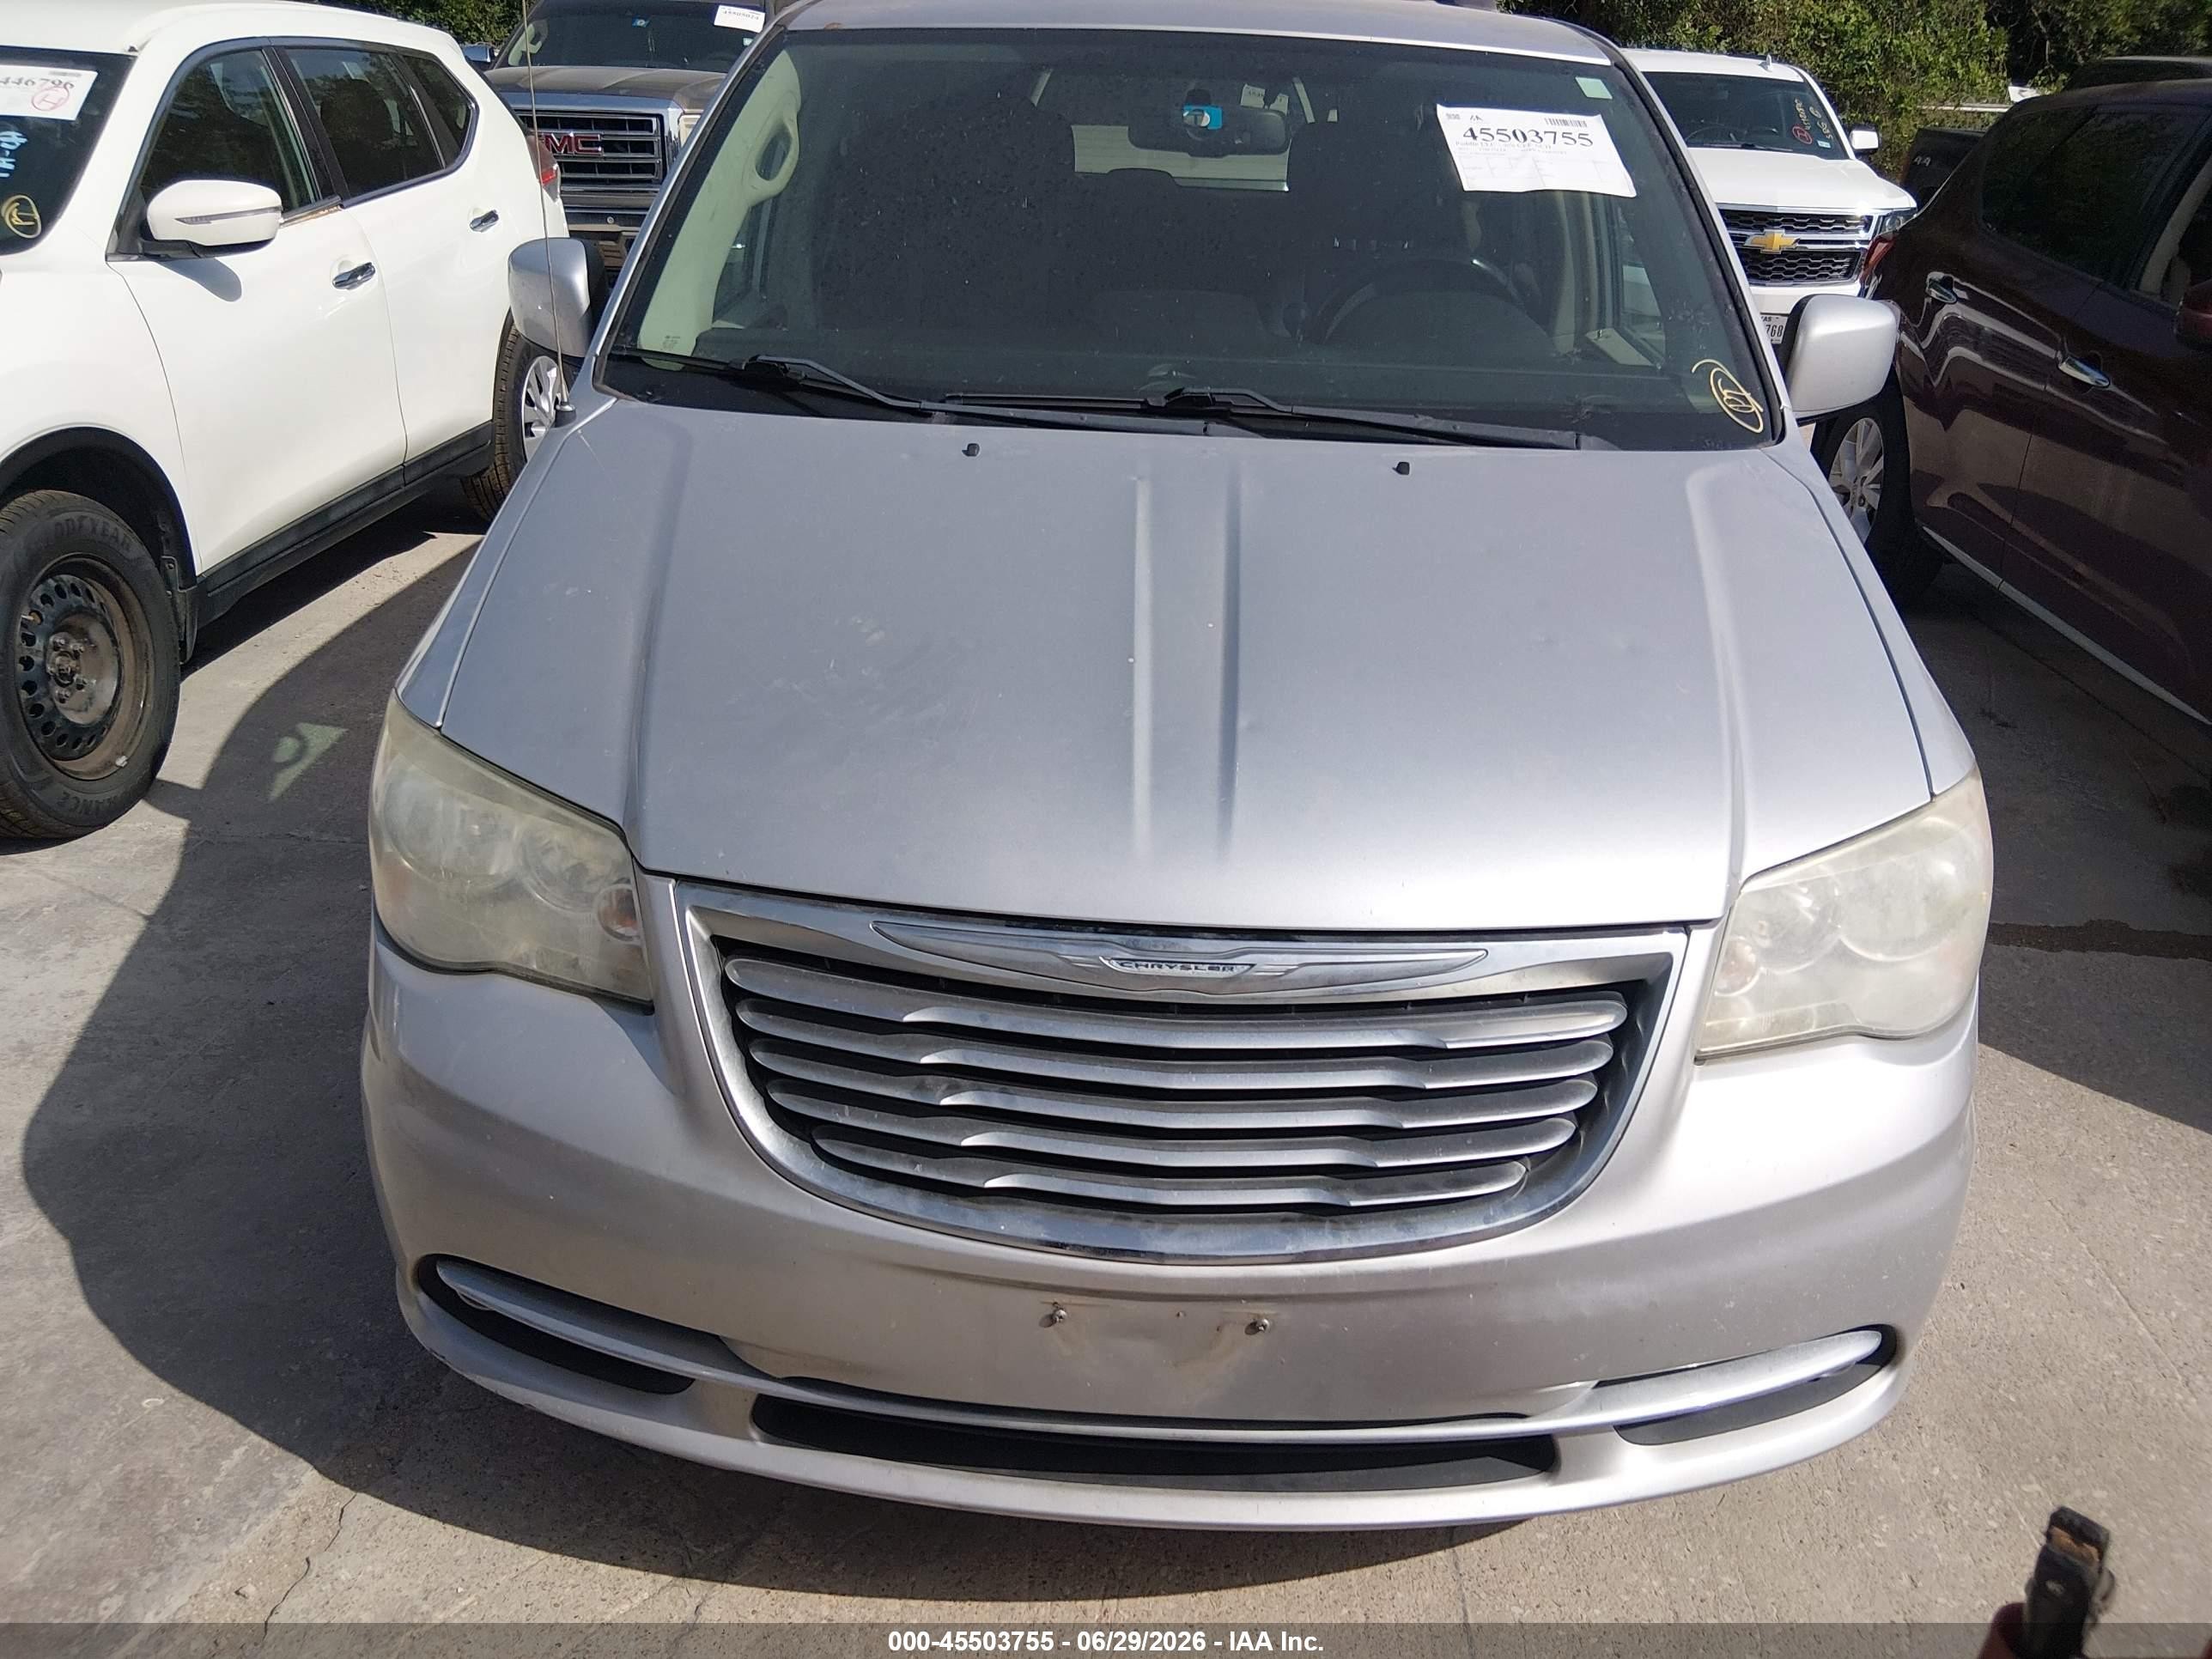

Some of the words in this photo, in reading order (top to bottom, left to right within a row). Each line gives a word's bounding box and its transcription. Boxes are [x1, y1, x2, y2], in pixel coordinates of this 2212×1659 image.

[542, 132, 602, 155] MC
[1462, 126, 1595, 148] 45503755
[1119, 960, 1235, 972] CHRYSLER
